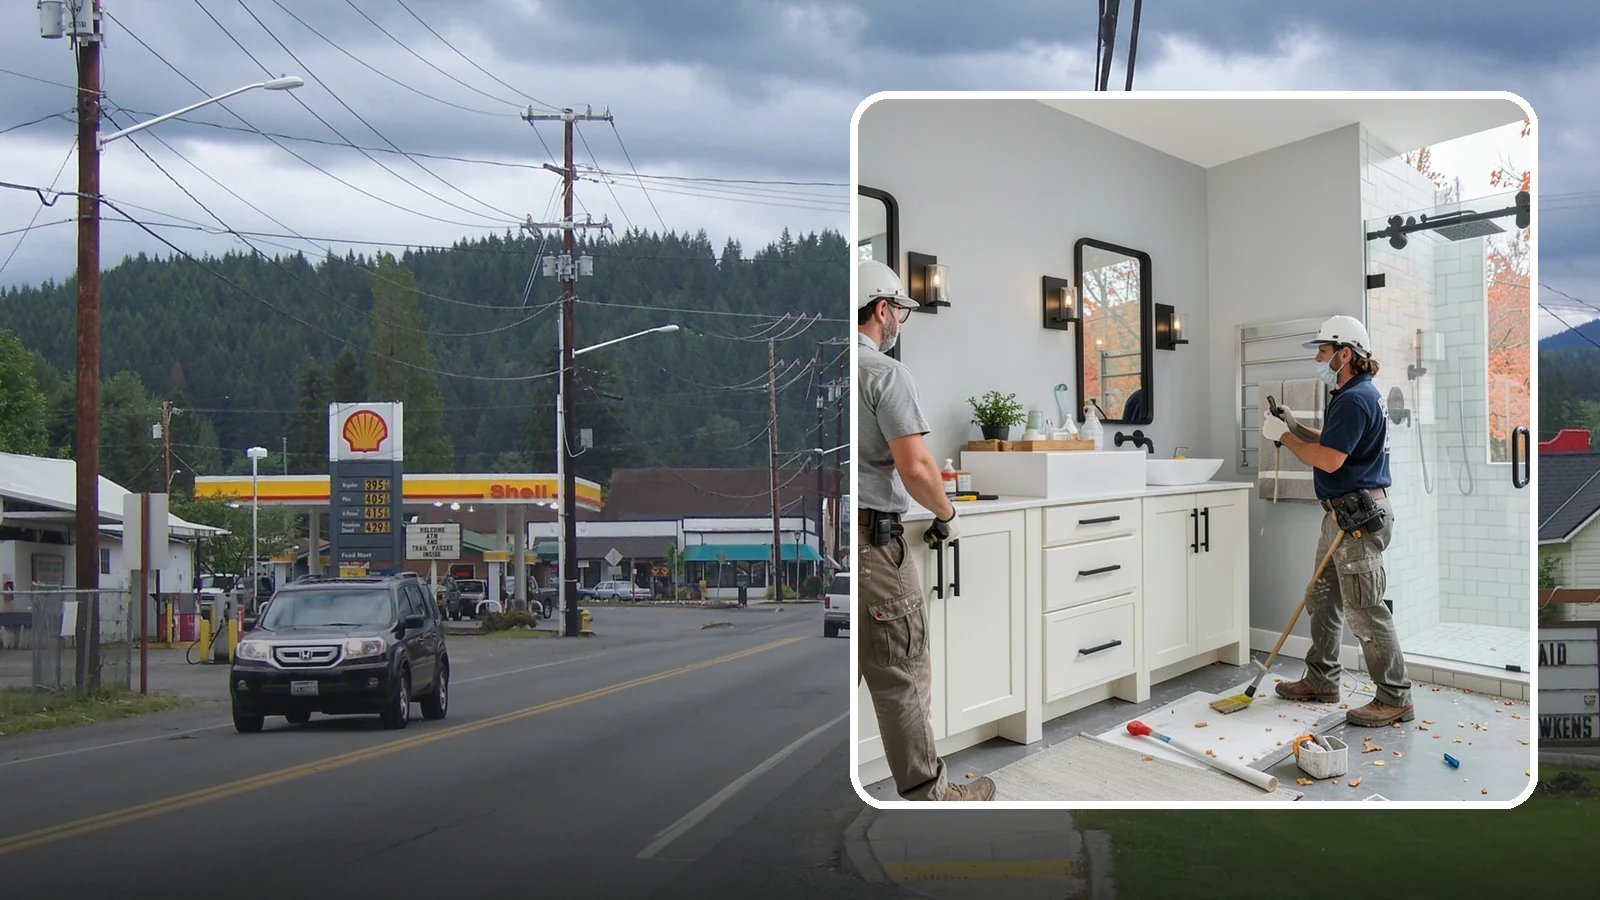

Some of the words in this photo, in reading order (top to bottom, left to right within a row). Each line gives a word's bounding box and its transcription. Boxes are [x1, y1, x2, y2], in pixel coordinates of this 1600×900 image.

[365, 480, 383, 490] 395
[490, 484, 547, 499] Shell
[365, 494, 383, 504] 405
[365, 508, 383, 518] 415
[365, 522, 383, 532] 429
[1539, 643, 1567, 665] AID
